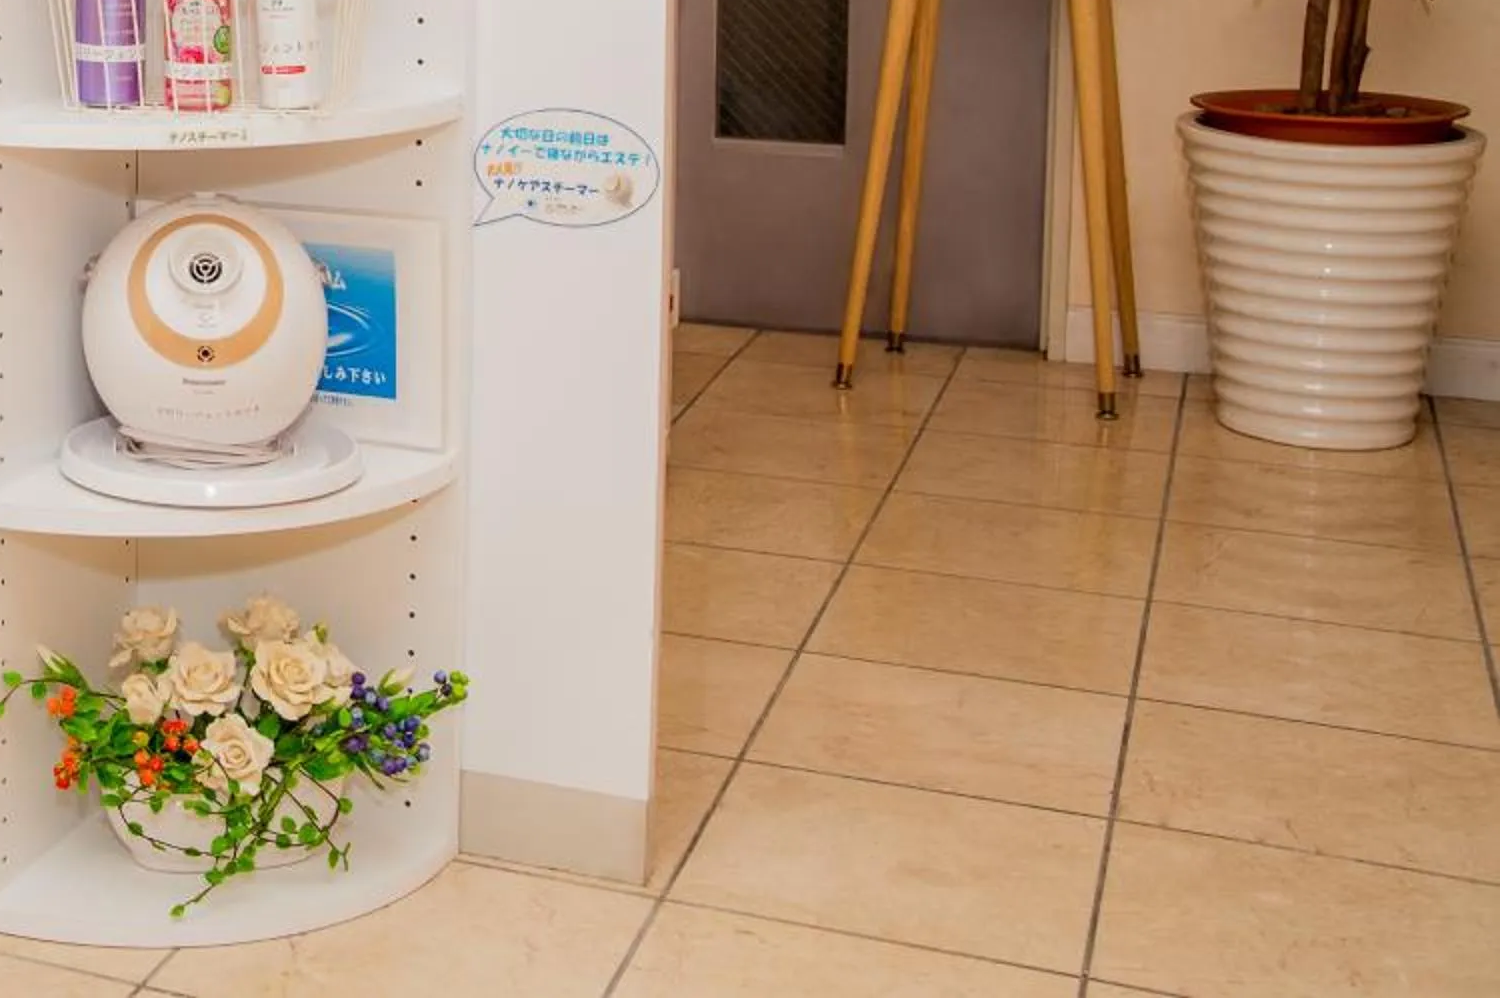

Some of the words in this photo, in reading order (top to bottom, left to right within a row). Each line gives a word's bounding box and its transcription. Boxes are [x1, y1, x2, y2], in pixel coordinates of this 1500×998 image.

[500, 126, 611, 147] 大切な日の前日は
[494, 177, 600, 197] ナノケアスチーマー
